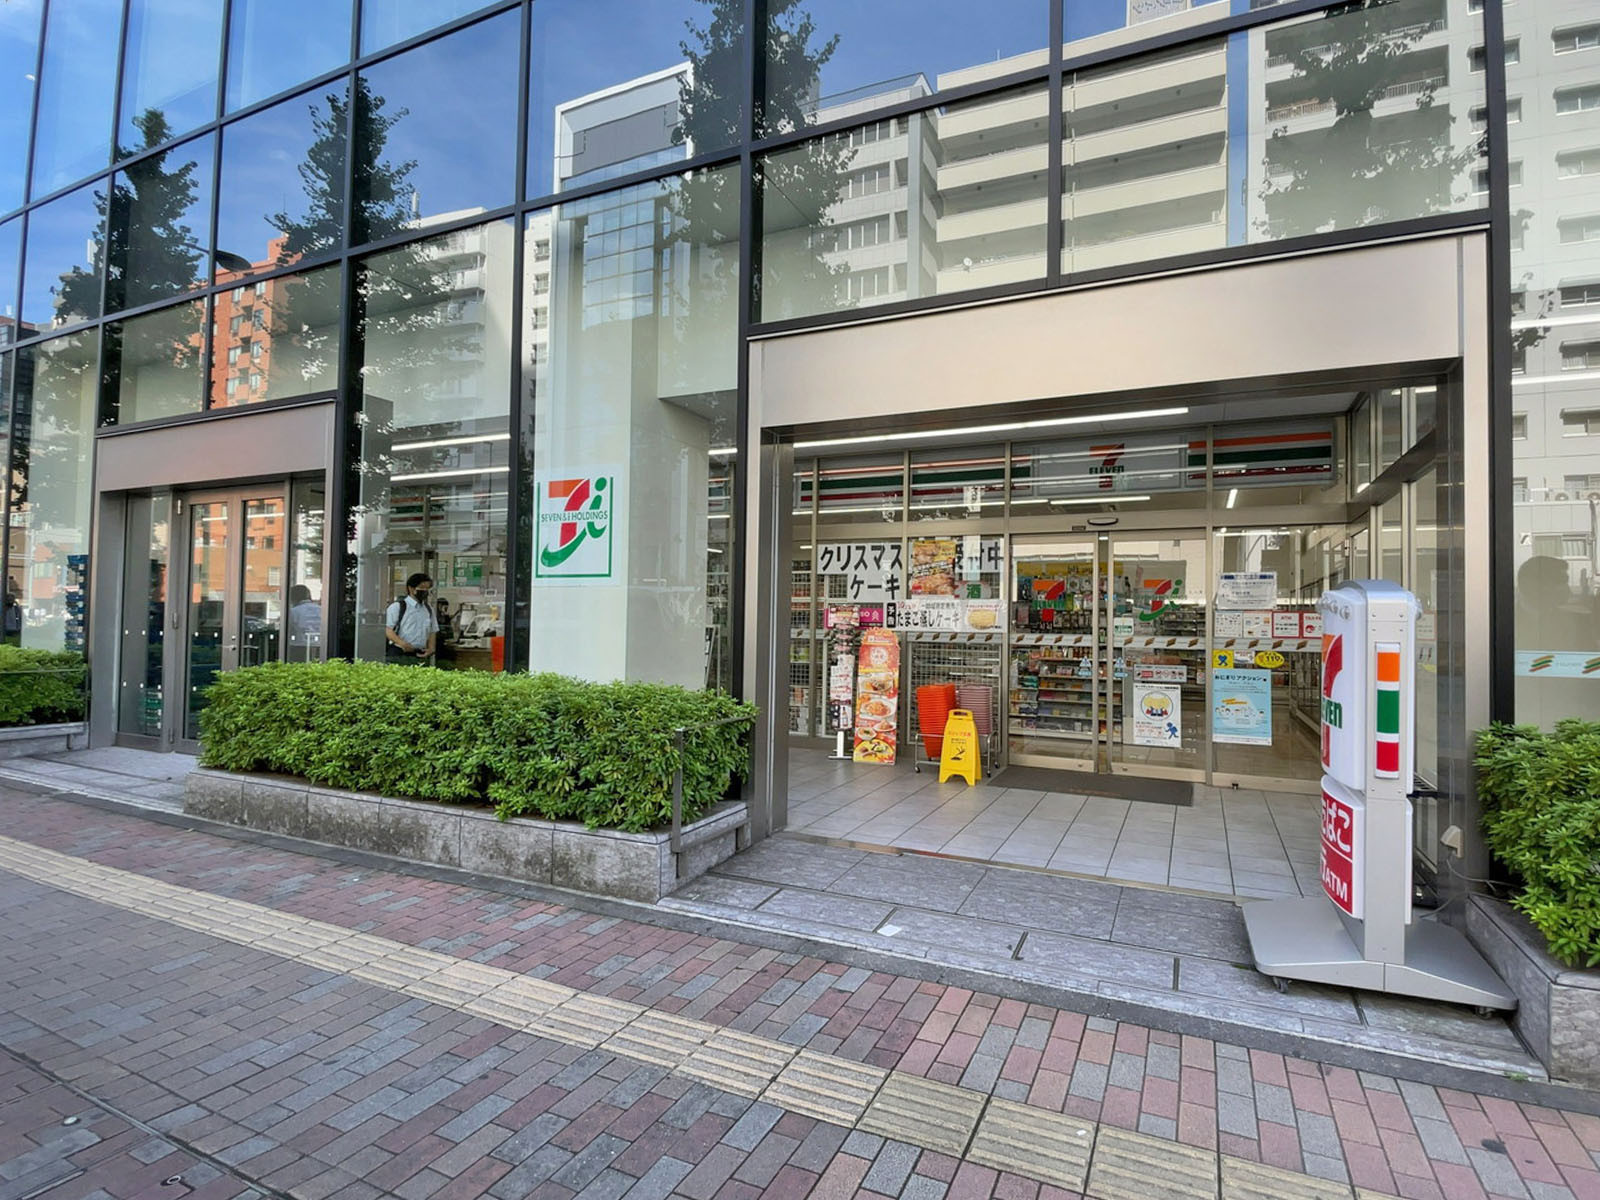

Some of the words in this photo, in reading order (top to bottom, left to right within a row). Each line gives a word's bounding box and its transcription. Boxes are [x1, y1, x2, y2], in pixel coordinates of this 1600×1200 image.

[571, 510, 608, 521] HOLDINGS
[820, 544, 903, 572] クリスマス
[850, 574, 900, 600] ケーキ
